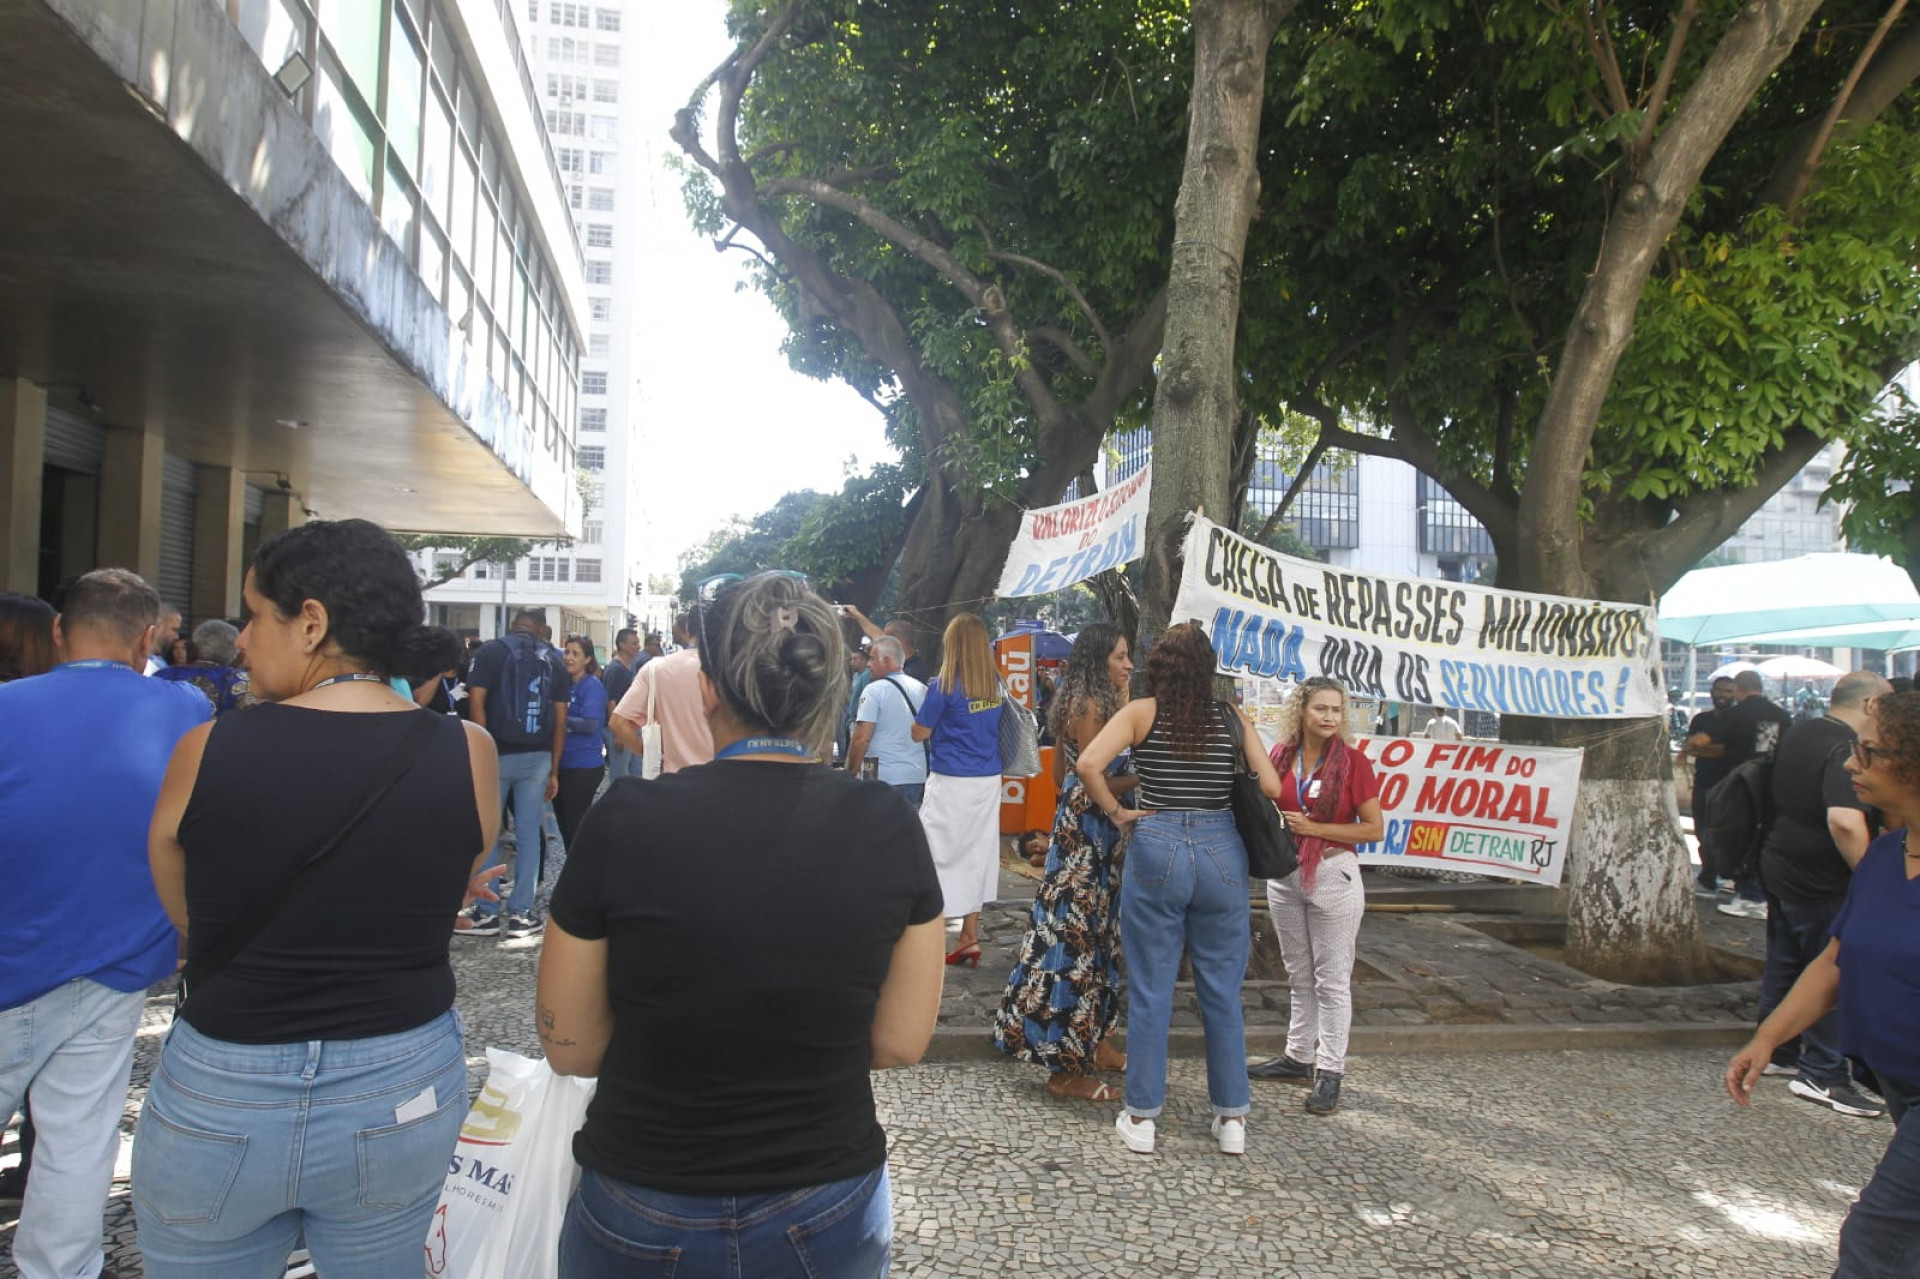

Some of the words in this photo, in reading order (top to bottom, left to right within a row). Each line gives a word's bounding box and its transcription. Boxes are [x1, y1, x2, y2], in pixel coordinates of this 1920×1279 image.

[1010, 512, 1137, 596] DETRAN
[1078, 529, 1098, 551] DO
[1205, 527, 1292, 613] CHEGA
[1293, 583, 1322, 620] DE
[1322, 571, 1466, 645] REPASSES
[1210, 607, 1306, 683] NADA
[1319, 635, 1386, 698] PARA
[1396, 651, 1433, 704] OS
[1425, 744, 1504, 773] FIM
[1505, 755, 1537, 778] DO
[1414, 776, 1559, 829] MORAL
[1450, 830, 1525, 862] DETRAN
[1530, 839, 1558, 867] RJ
